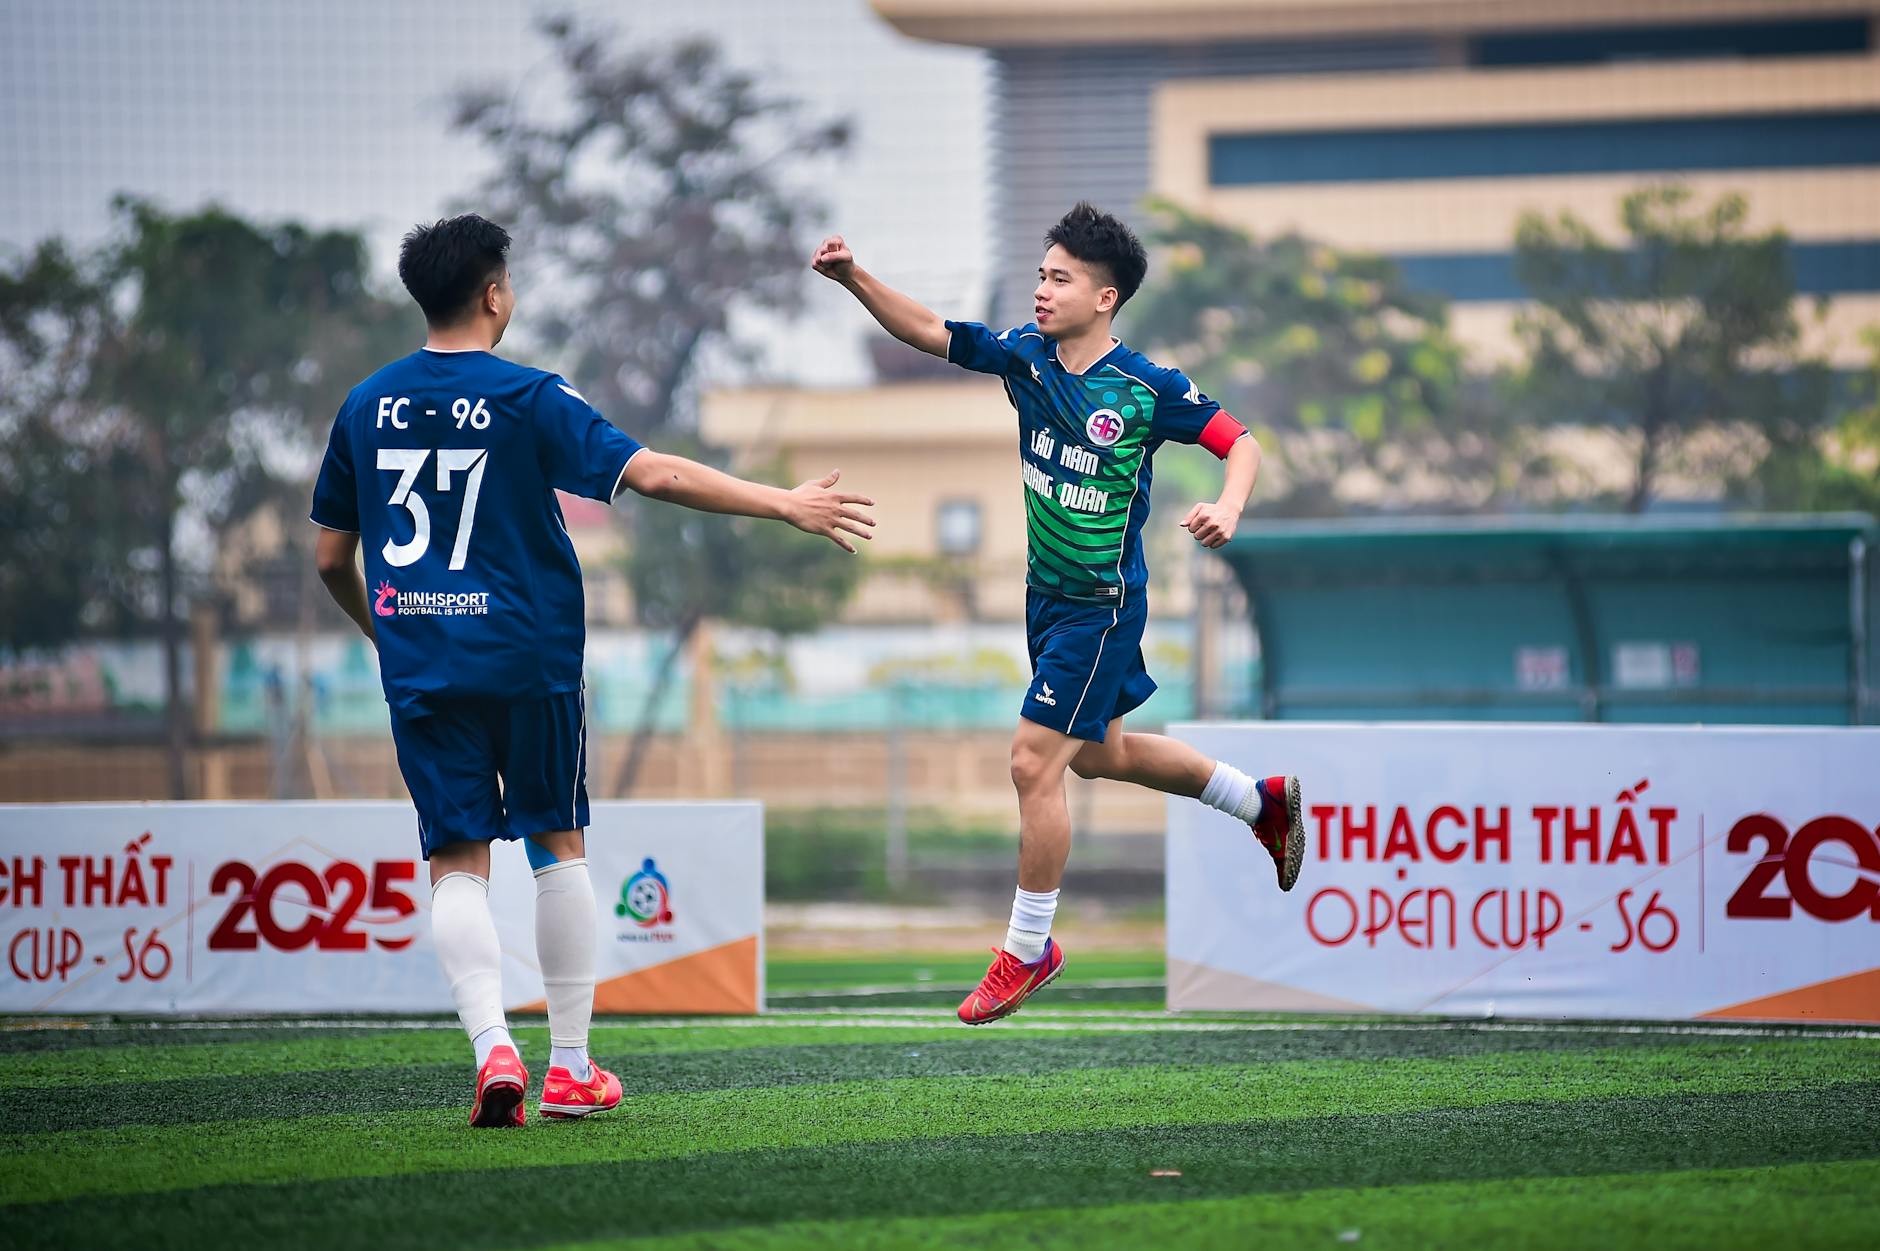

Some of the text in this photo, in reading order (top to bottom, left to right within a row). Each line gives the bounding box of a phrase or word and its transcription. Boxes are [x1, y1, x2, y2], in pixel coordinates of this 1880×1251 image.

[376, 396, 491, 430] FC - 96
[1031, 427, 1055, 460] LẨU
[376, 449, 489, 570] 37
[1060, 482, 1109, 514] QUÂN
[398, 606, 489, 616] FOOTBALL IS MY LIFE
[1310, 778, 1678, 880] THẠCH THẤT
[57, 831, 173, 907] THẤT
[208, 860, 417, 952] 2025
[1305, 887, 1457, 950] OPEN
[1472, 887, 1564, 951] CUP
[1609, 888, 1680, 953] S6
[8, 927, 83, 983] CUP
[116, 927, 173, 983] S6
